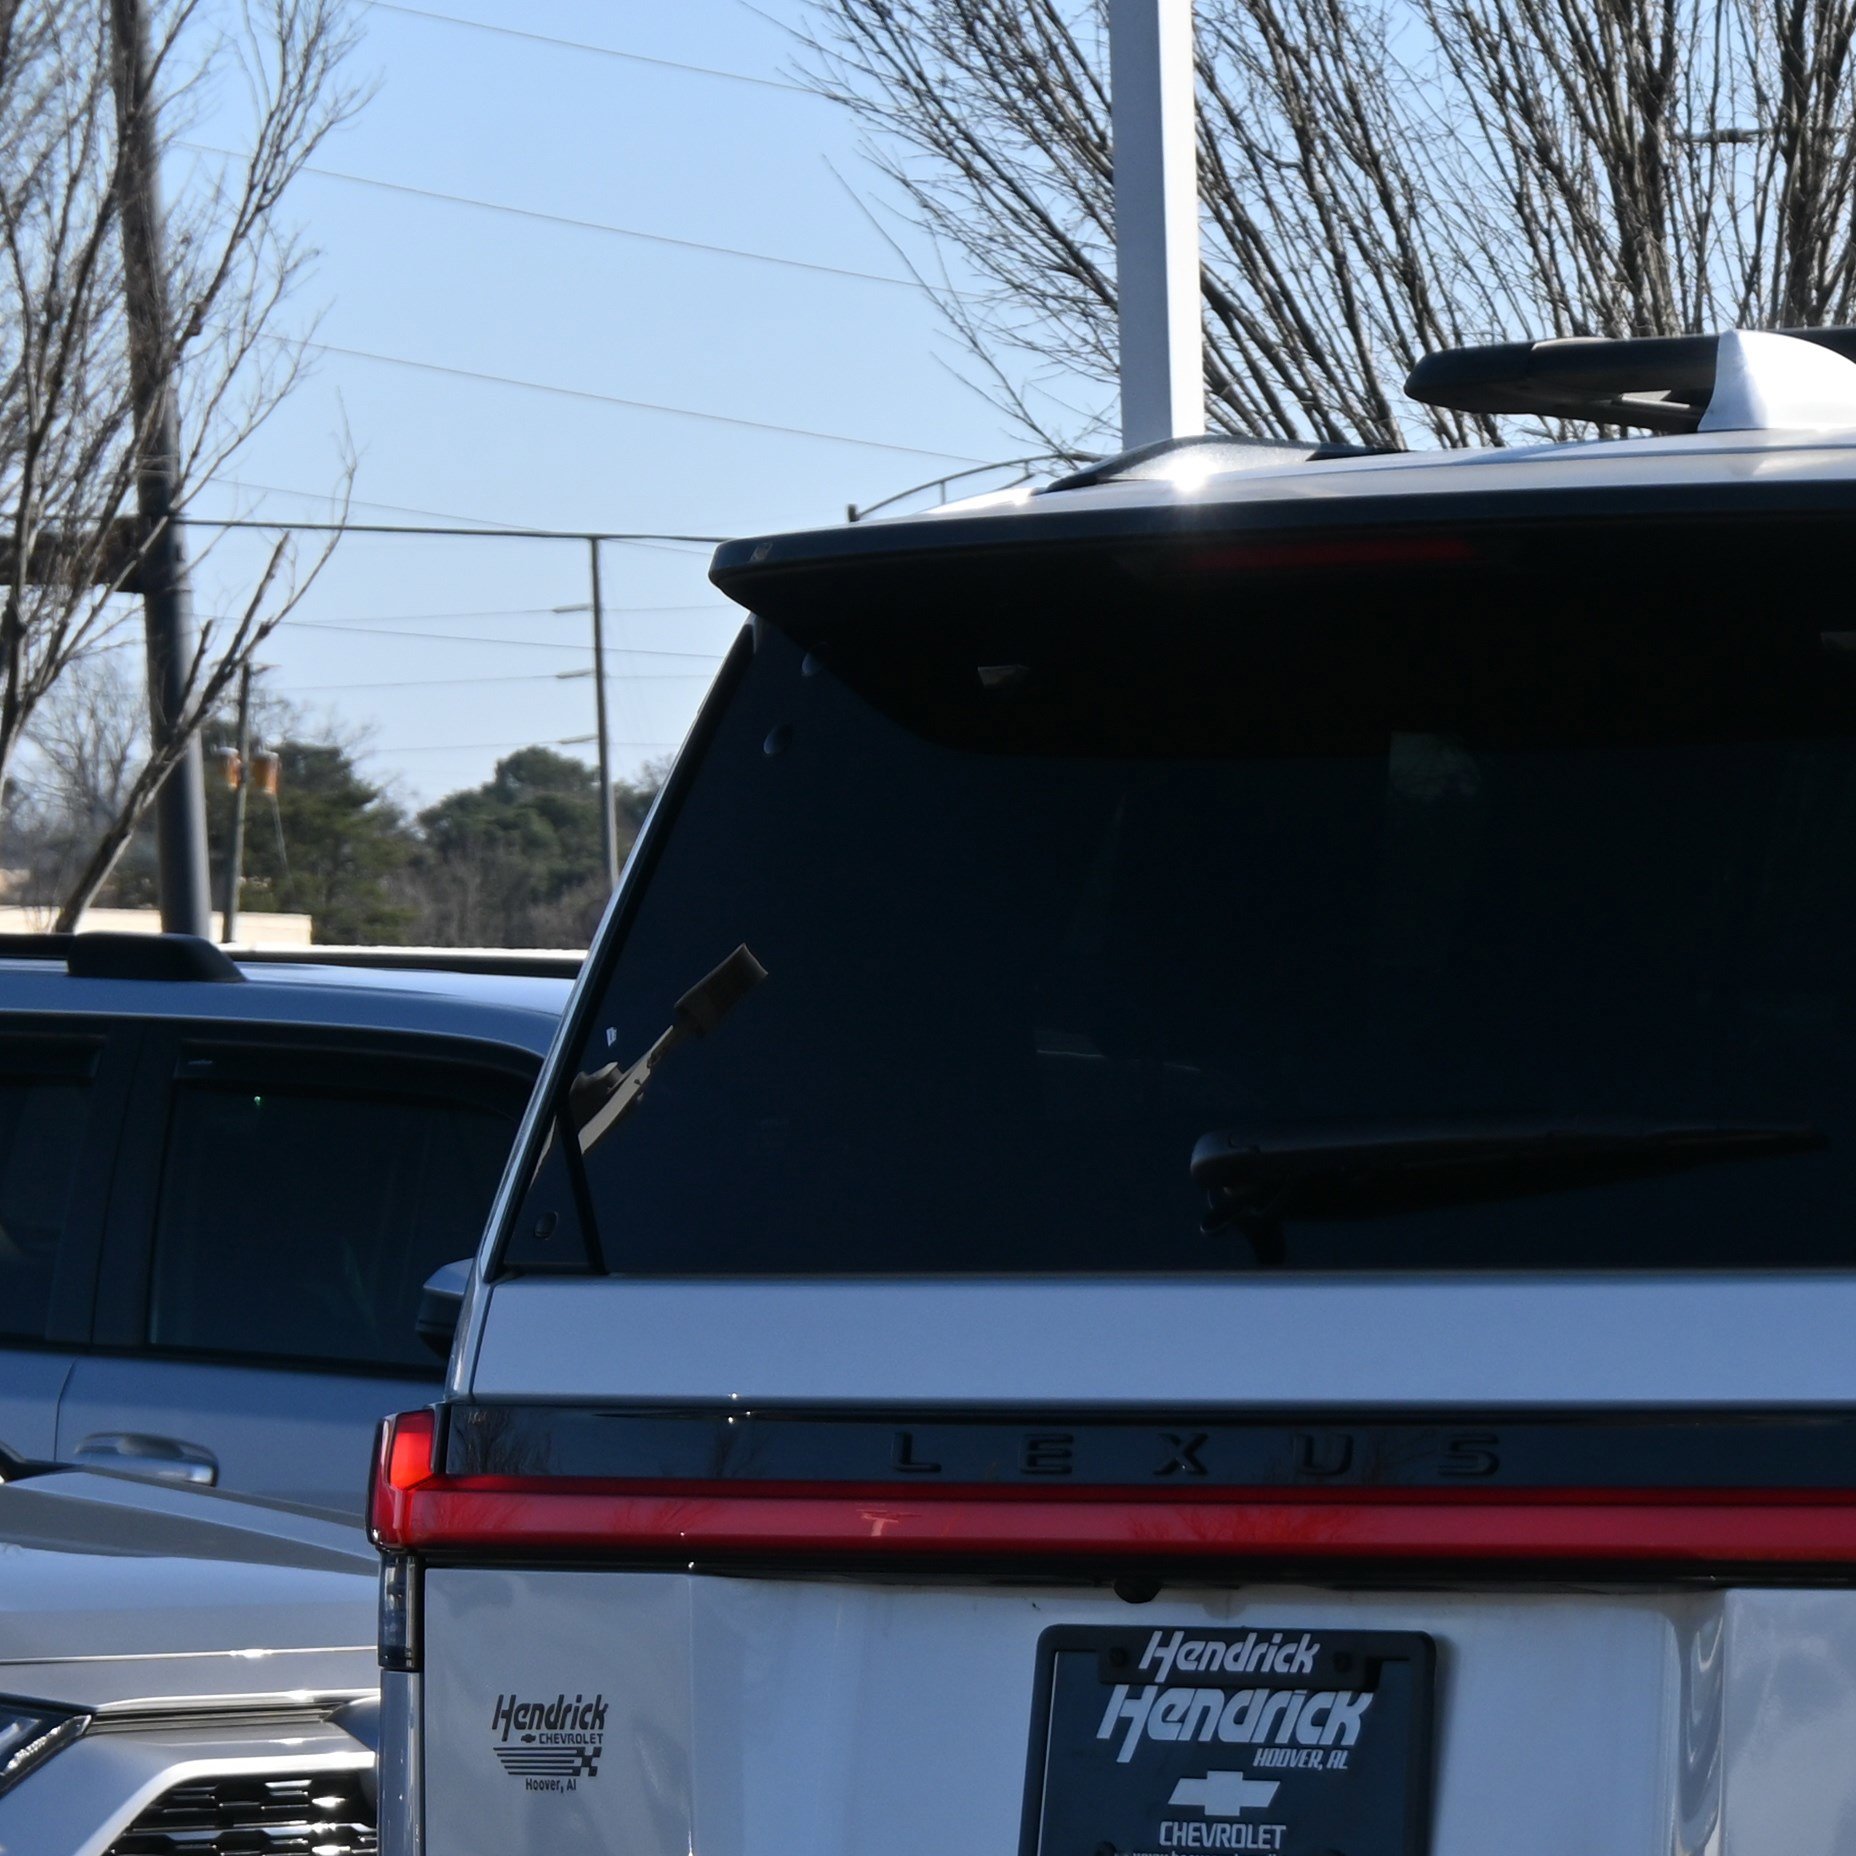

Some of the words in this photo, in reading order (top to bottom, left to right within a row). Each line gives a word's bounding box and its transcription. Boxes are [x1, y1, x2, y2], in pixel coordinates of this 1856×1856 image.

[891, 1430, 1501, 1478] LEXUS
[1138, 1630, 1321, 1683] Hendrick
[491, 1694, 609, 1742] Hendrick
[1096, 1684, 1375, 1764] Hendrick
[538, 1733, 604, 1745] CHEVROLET
[1252, 1747, 1324, 1771] HOOVER,
[1326, 1749, 1349, 1770] AL
[525, 1778, 564, 1794] Hoover,
[1158, 1820, 1288, 1851] CHEVROLET
